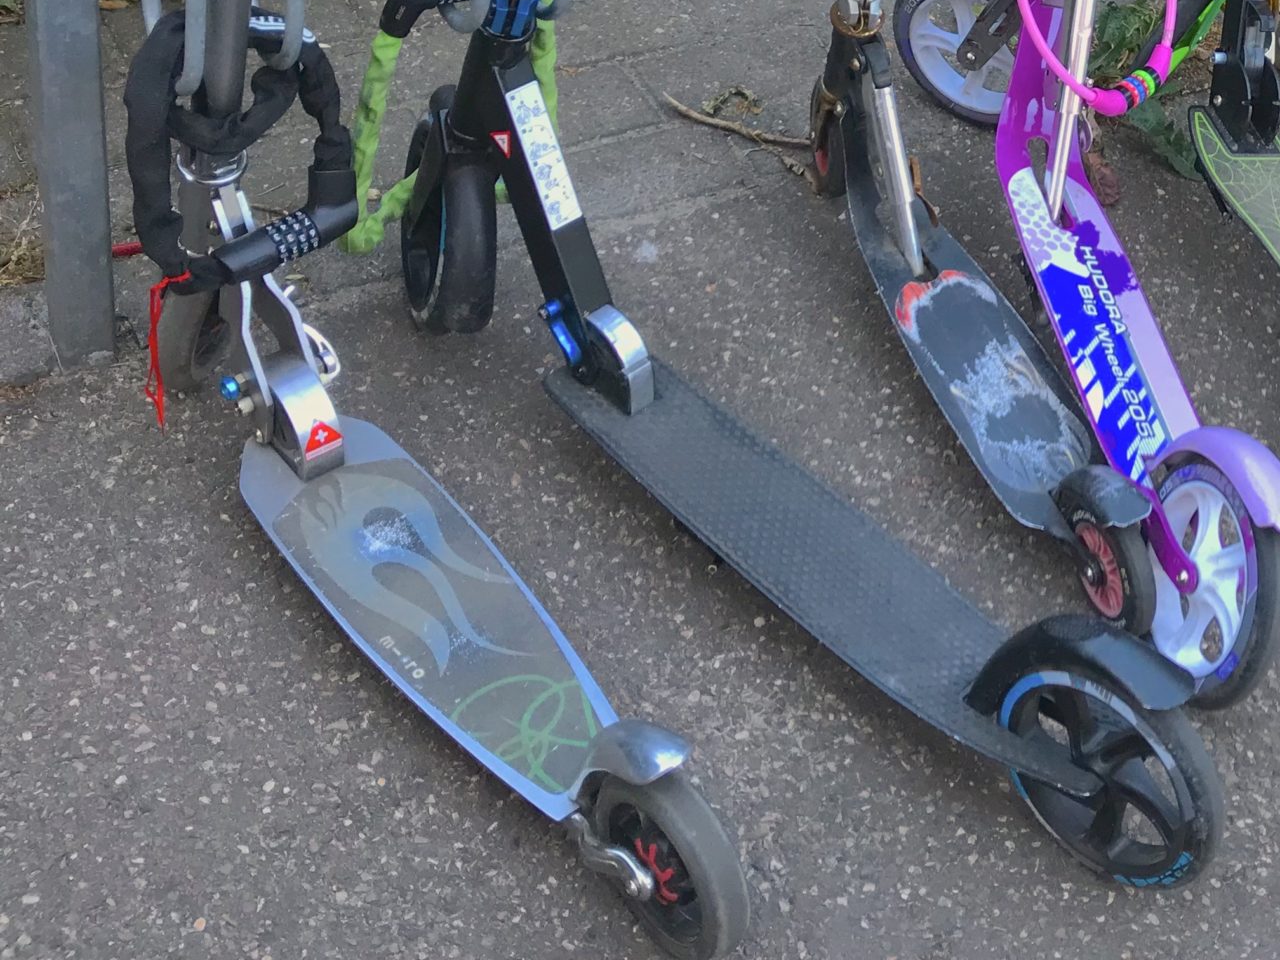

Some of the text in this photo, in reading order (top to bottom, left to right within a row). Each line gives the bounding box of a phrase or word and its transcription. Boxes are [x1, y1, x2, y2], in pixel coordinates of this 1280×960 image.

[1079, 245, 1126, 335] HUDORA
[1077, 284, 1151, 437] Big Wheel 205
